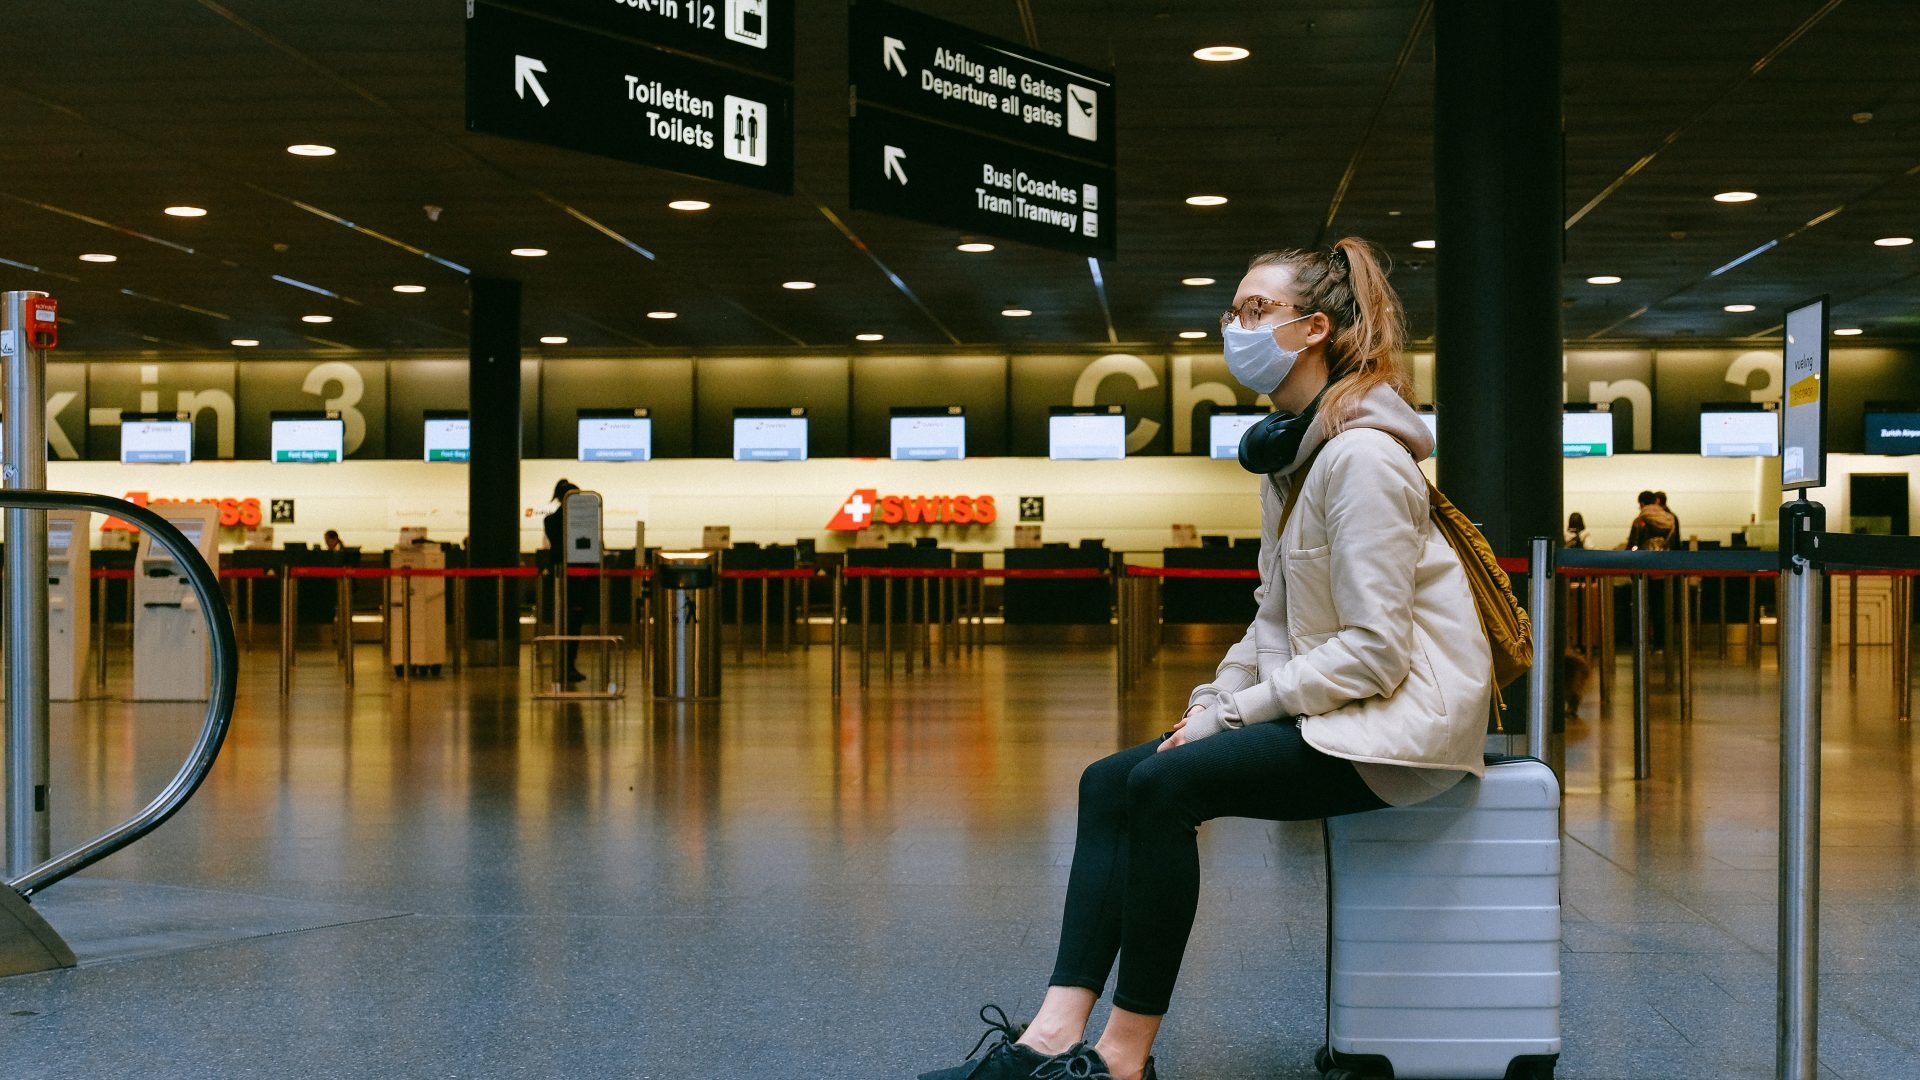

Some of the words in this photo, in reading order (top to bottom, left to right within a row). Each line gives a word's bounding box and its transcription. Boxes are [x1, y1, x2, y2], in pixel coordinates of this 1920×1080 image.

[615, 0, 678, 19] k-in
[624, 74, 714, 120] Toiletten
[933, 46, 985, 84] Abflug
[989, 65, 1017, 90] alle
[1020, 73, 1062, 103] Gates
[921, 68, 998, 110] Departure
[1001, 94, 1020, 116] all
[1022, 104, 1062, 128] gates
[645, 111, 714, 150] Toilets
[302, 361, 366, 457] 3
[880, 495, 997, 524] SWISS
